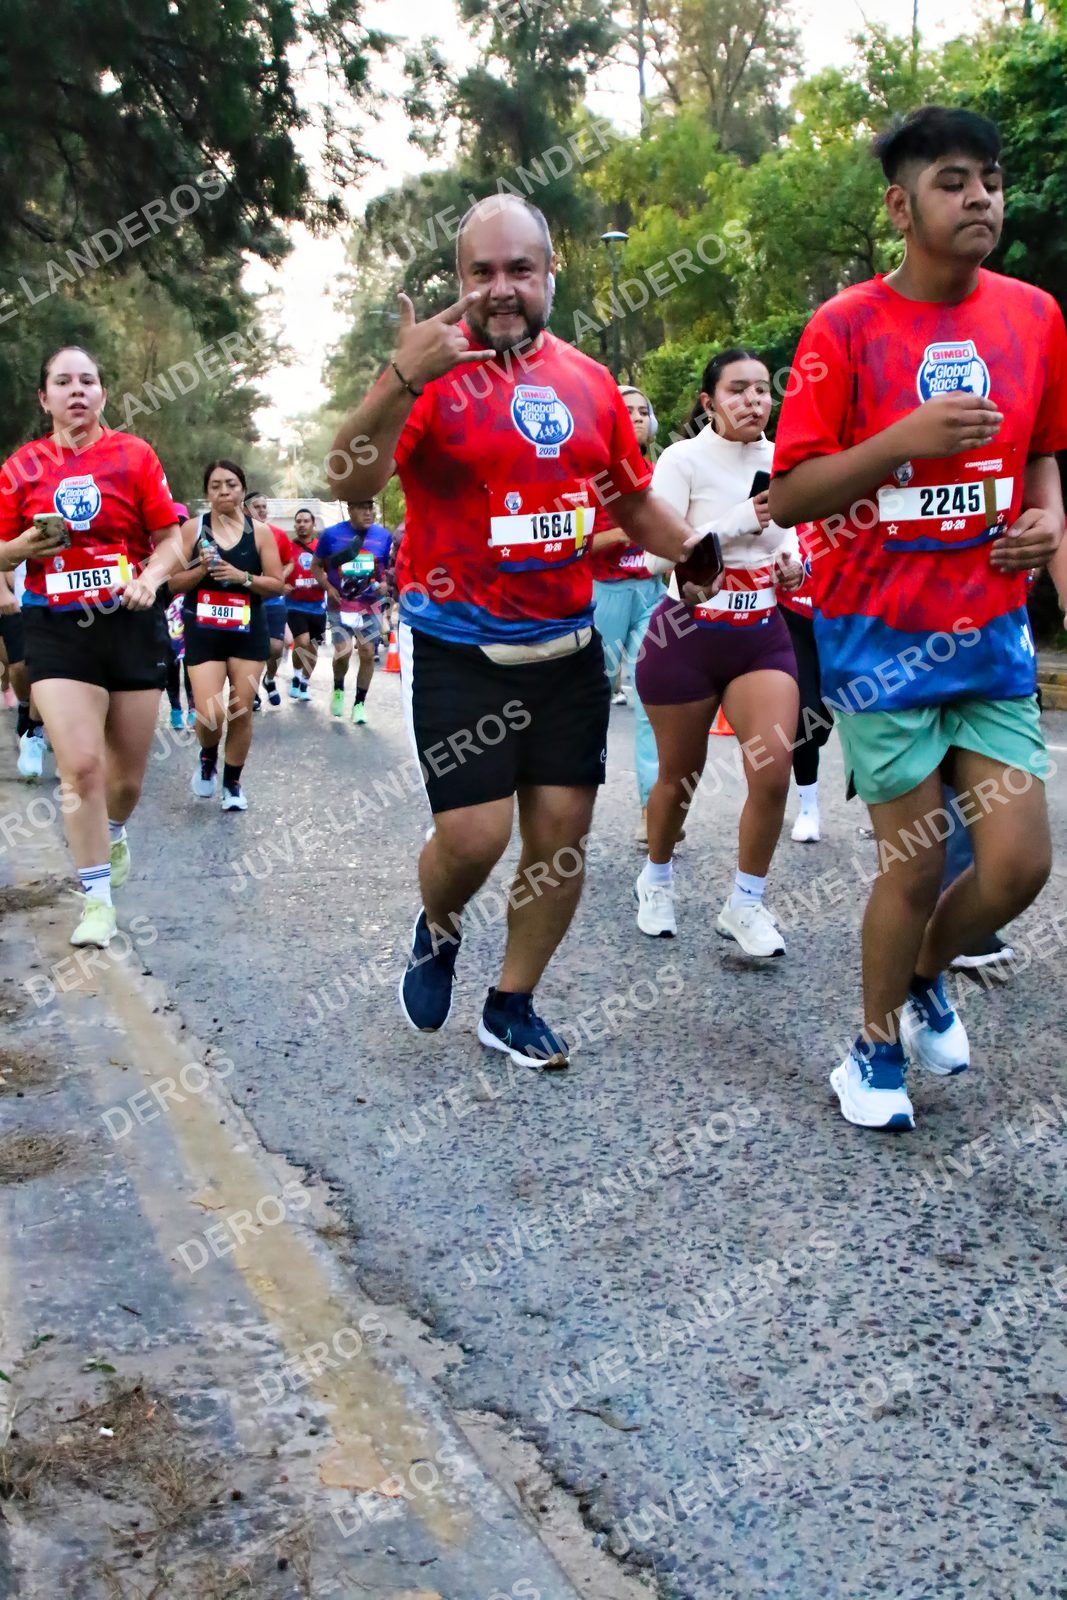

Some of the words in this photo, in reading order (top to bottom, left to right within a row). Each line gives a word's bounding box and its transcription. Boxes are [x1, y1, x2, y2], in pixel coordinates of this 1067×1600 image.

[931, 349, 970, 360] BIMBO
[935, 362, 971, 378] Global
[929, 378, 959, 392] Race
[525, 401, 555, 413] Global
[521, 410, 546, 421] Race
[539, 447, 558, 456] 2026
[920, 484, 980, 516] 2245
[530, 513, 572, 540] 1664
[67, 568, 112, 590] 17563
[727, 592, 758, 610] 1612
[211, 605, 234, 618] 3481
